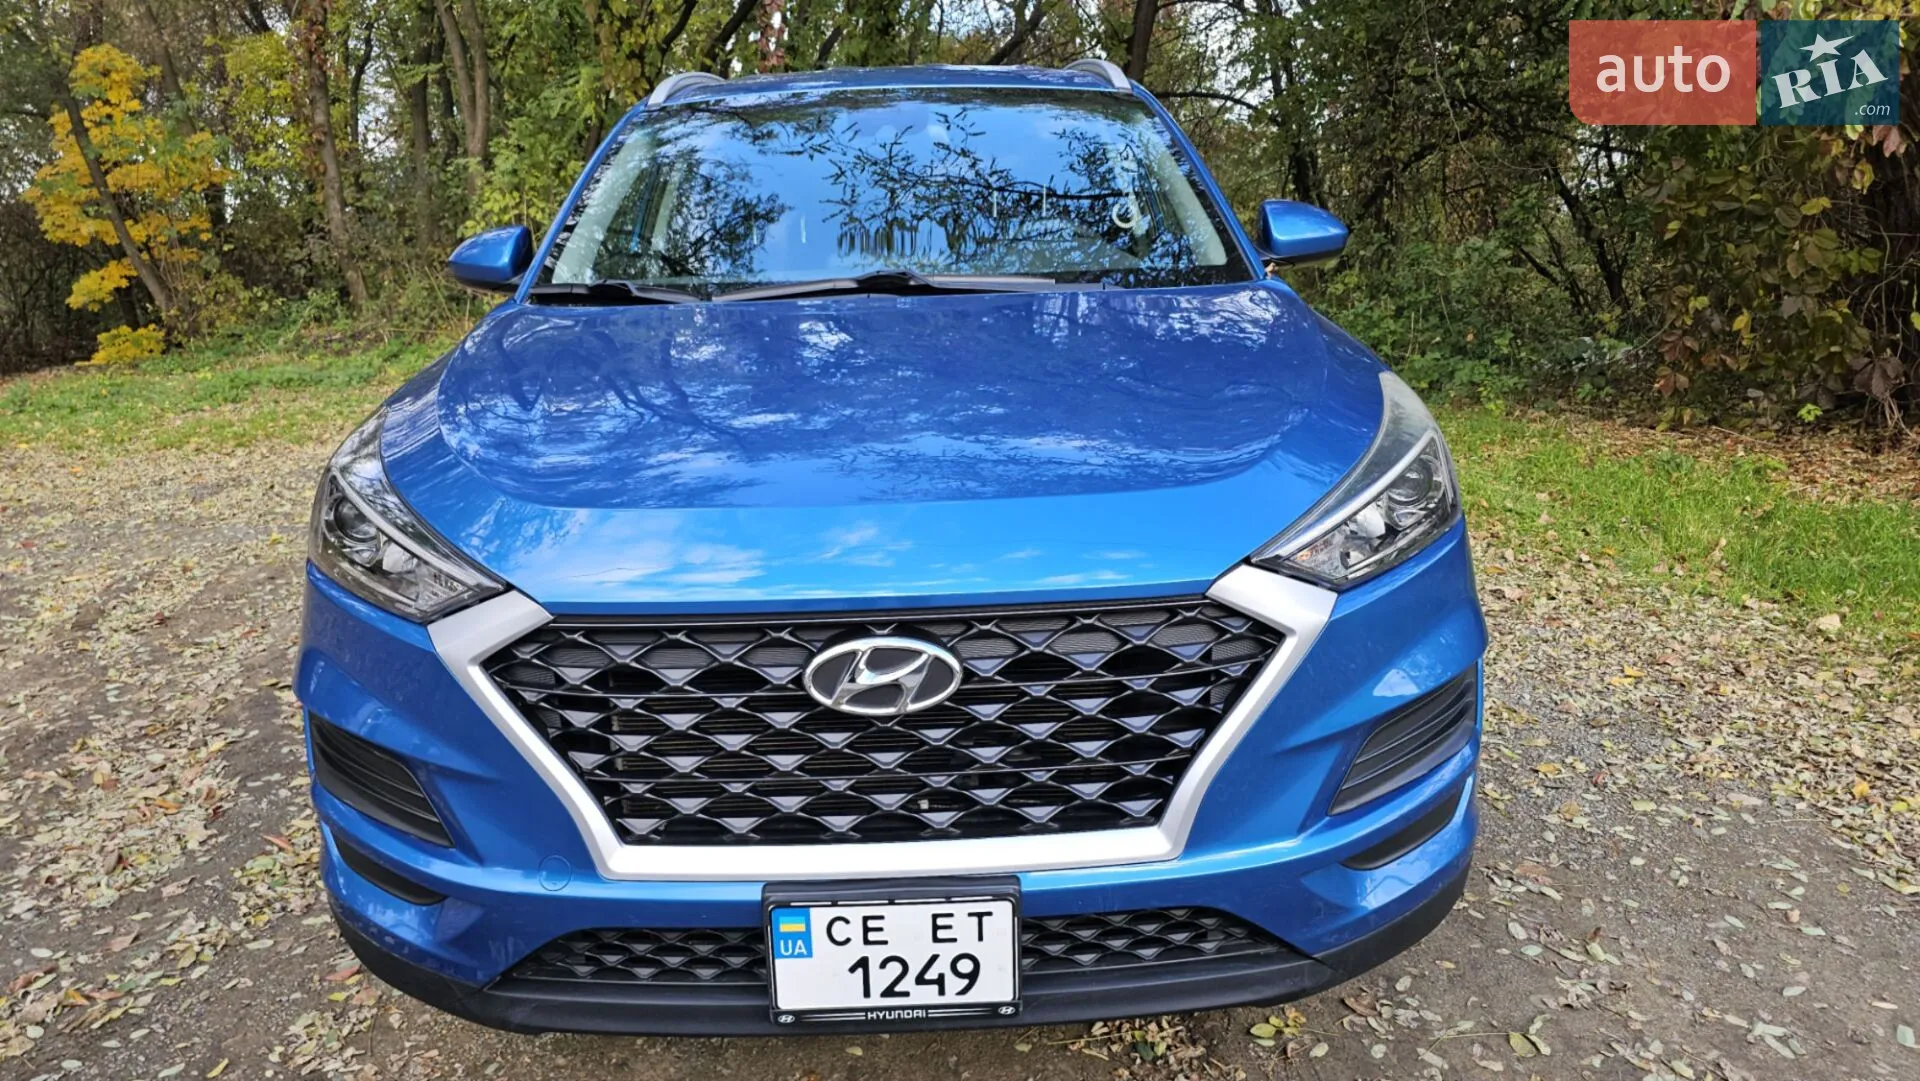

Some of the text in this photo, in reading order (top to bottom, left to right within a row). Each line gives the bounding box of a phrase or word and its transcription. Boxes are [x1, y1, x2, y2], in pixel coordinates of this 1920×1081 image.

[826, 911, 993, 947] CE ET
[779, 939, 807, 956] UA
[848, 952, 981, 999] 1249
[867, 1009, 927, 1020] HYUNDAI
